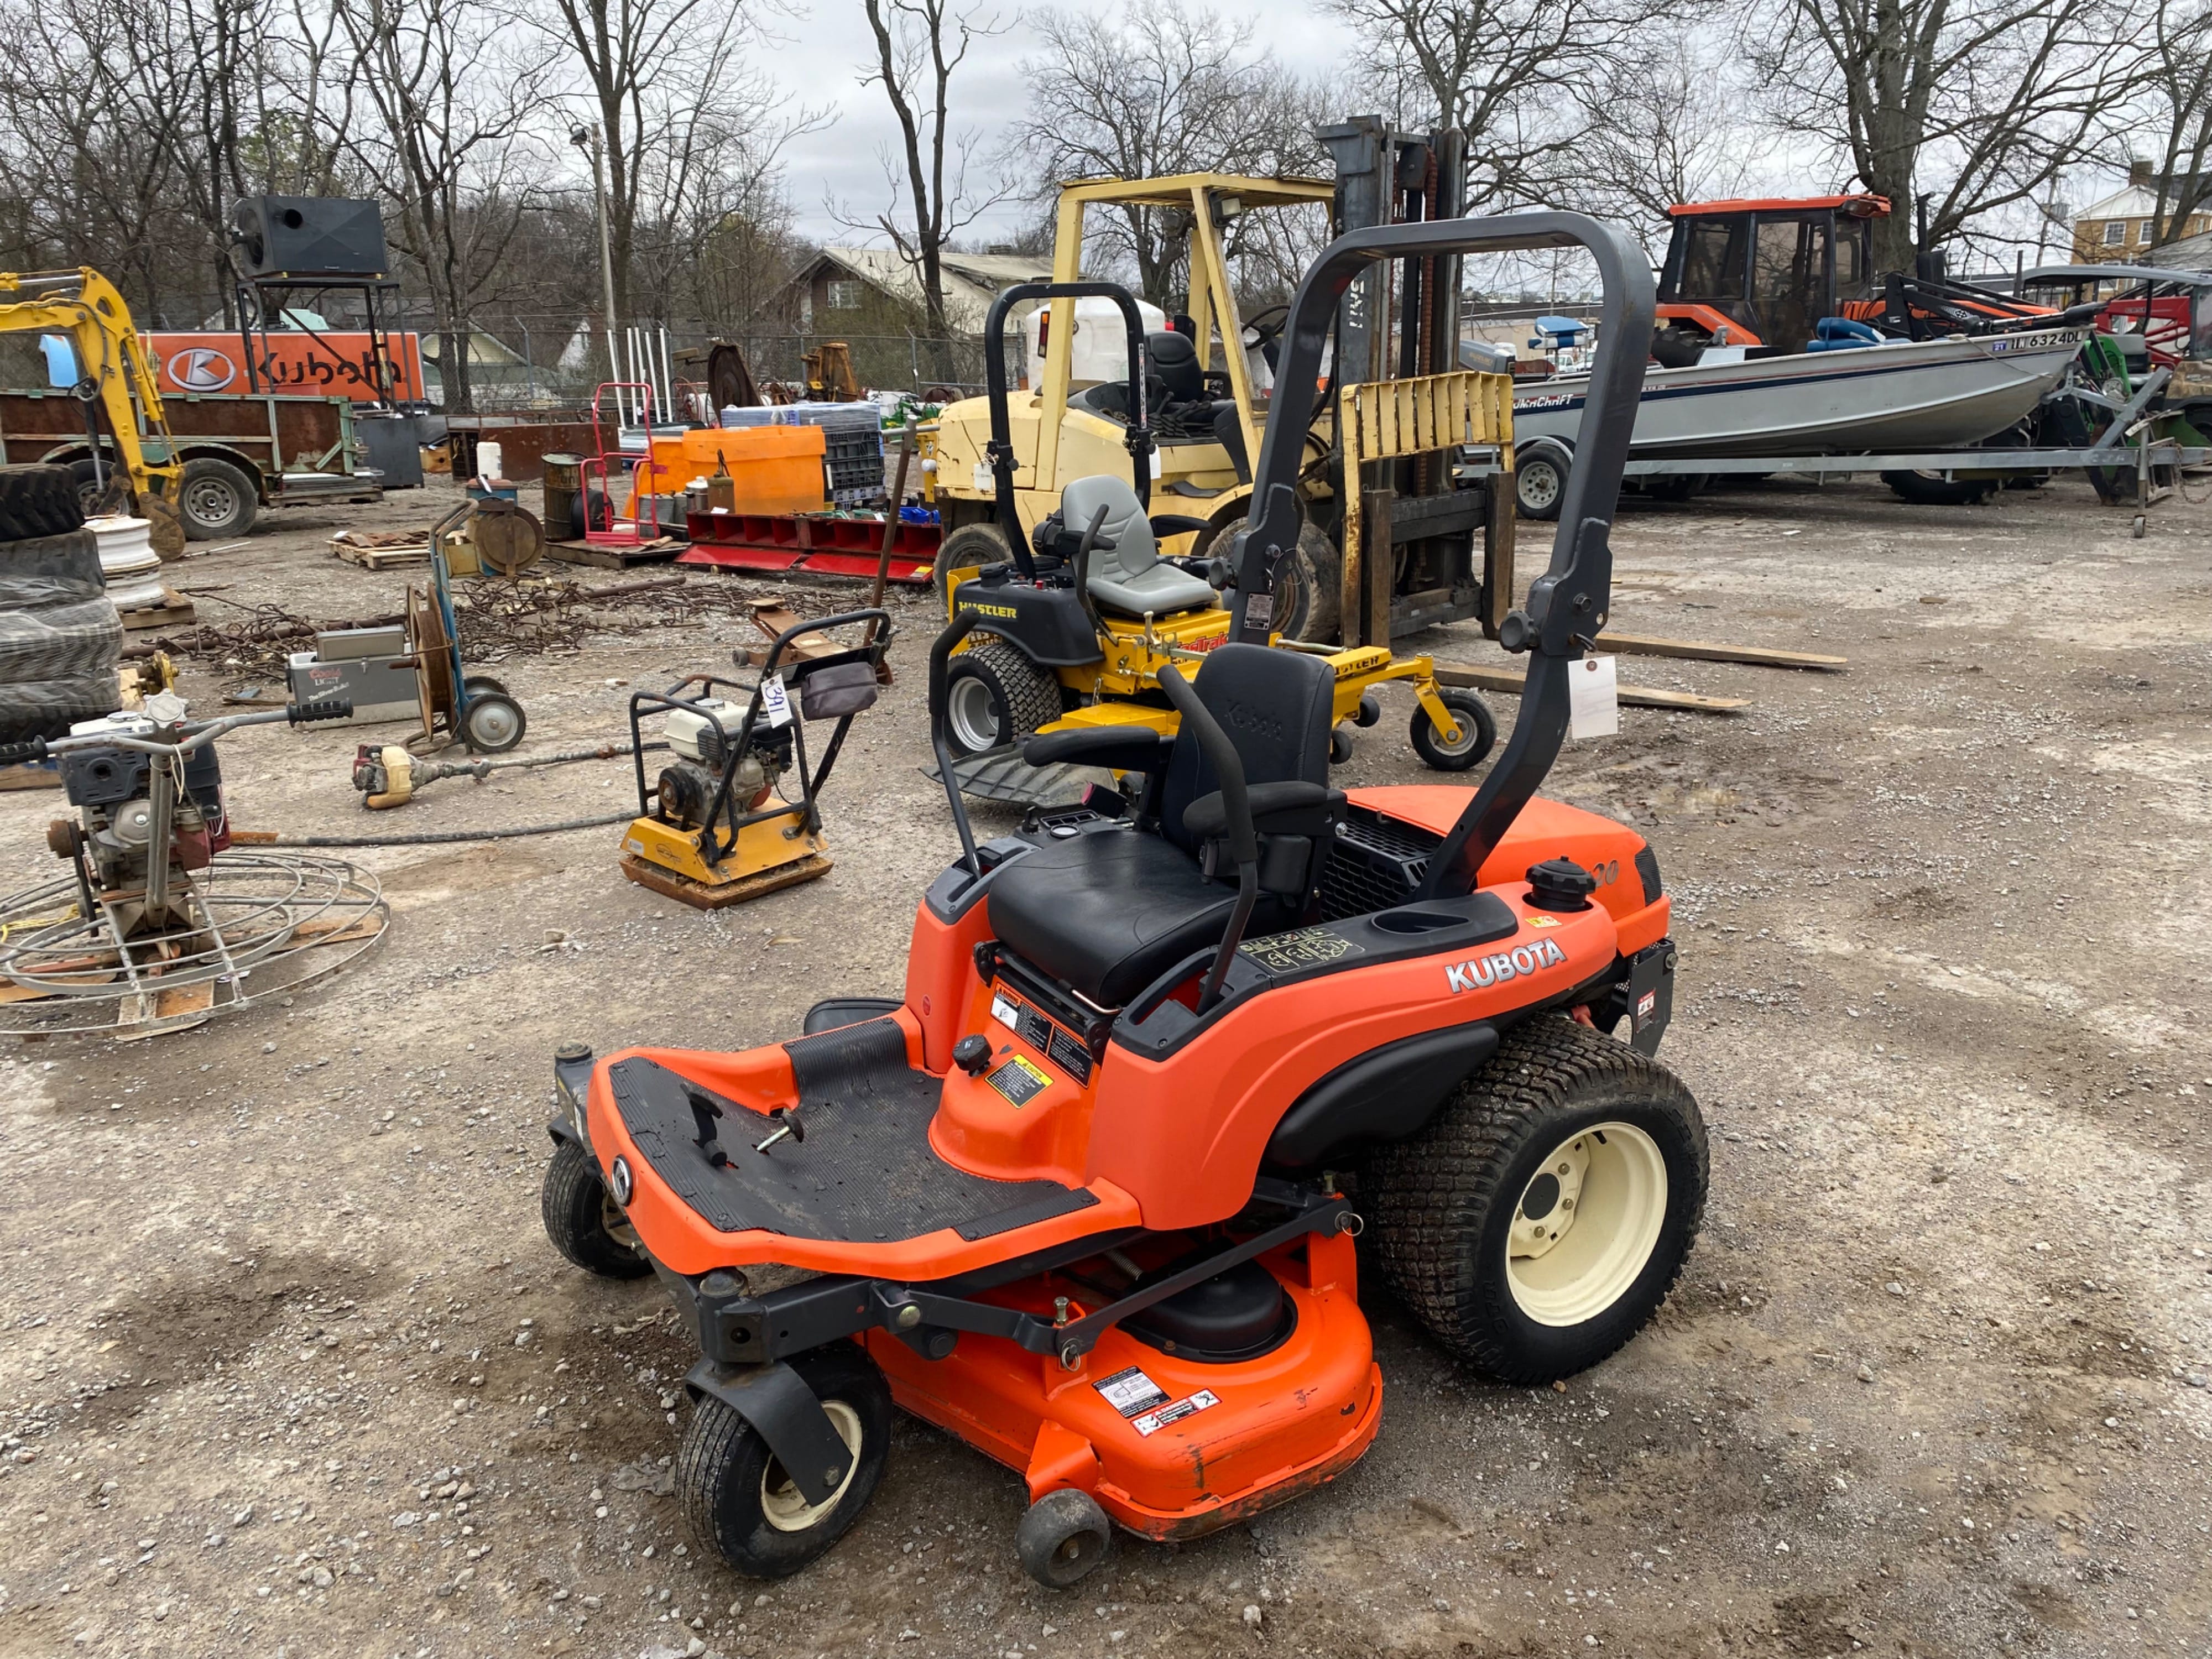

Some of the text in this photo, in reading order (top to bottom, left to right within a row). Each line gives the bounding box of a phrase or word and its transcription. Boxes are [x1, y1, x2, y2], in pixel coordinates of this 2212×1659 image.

[255, 352, 402, 384] Kubota
[1513, 393, 1574, 409] UMACRAFT
[315, 676, 340, 686] LIGHT
[1593, 859, 1619, 888] 20
[1444, 937, 1568, 994] KUBOTA
